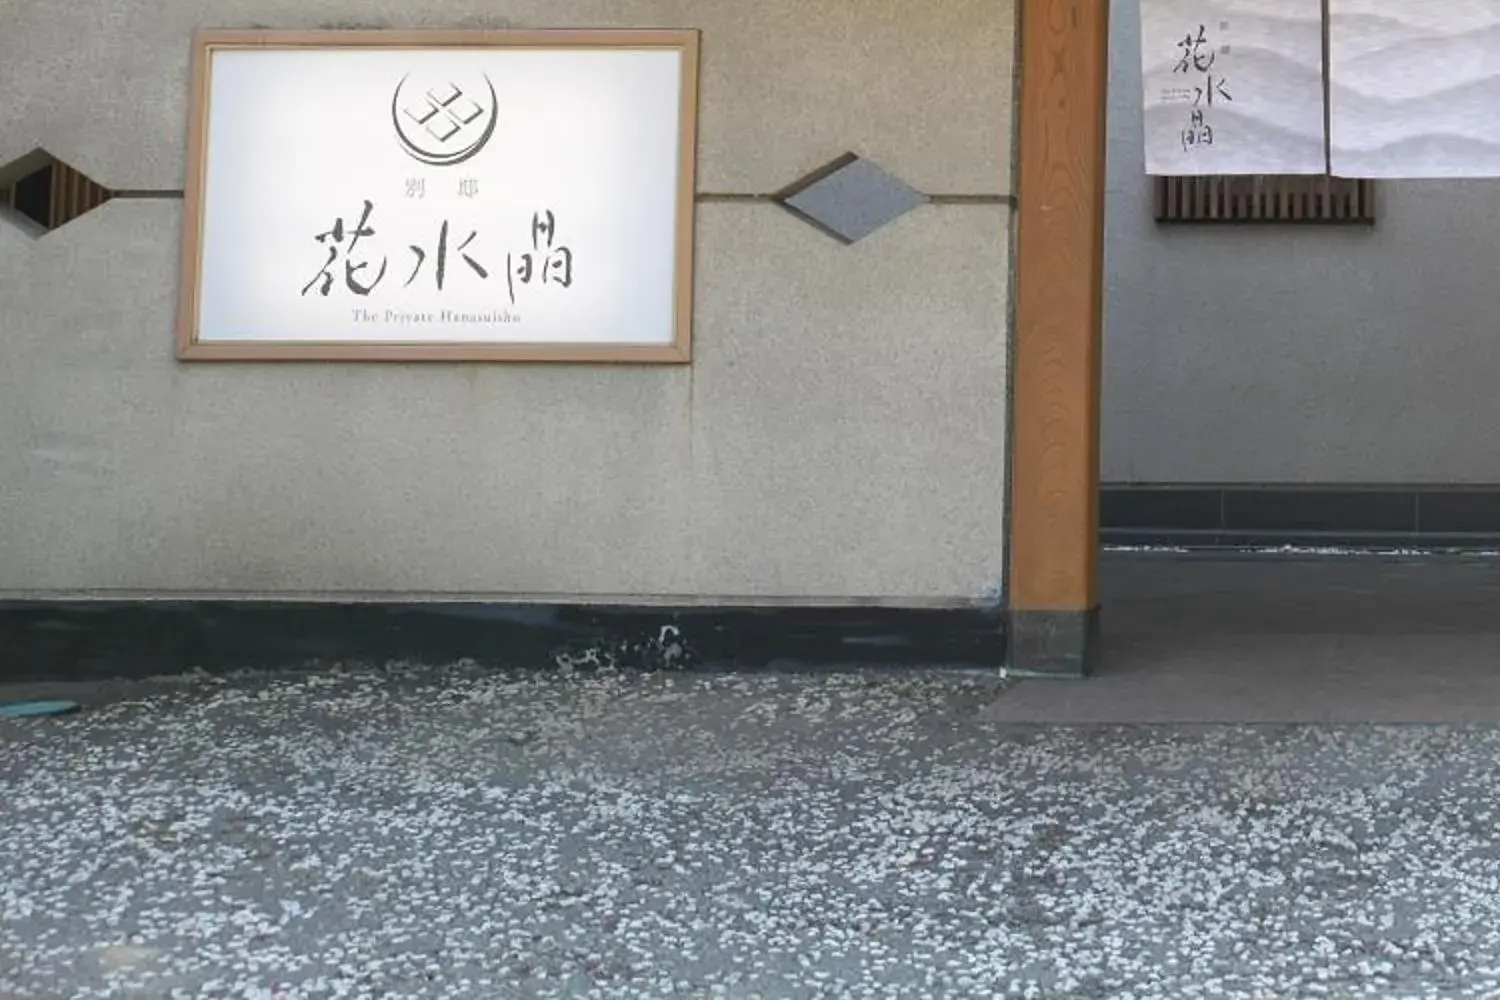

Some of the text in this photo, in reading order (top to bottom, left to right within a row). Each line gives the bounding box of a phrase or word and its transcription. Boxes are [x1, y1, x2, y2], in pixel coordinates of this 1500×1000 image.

[301, 200, 574, 304] 花水晶
[352, 308, 378, 323] The
[385, 309, 434, 324] Private
